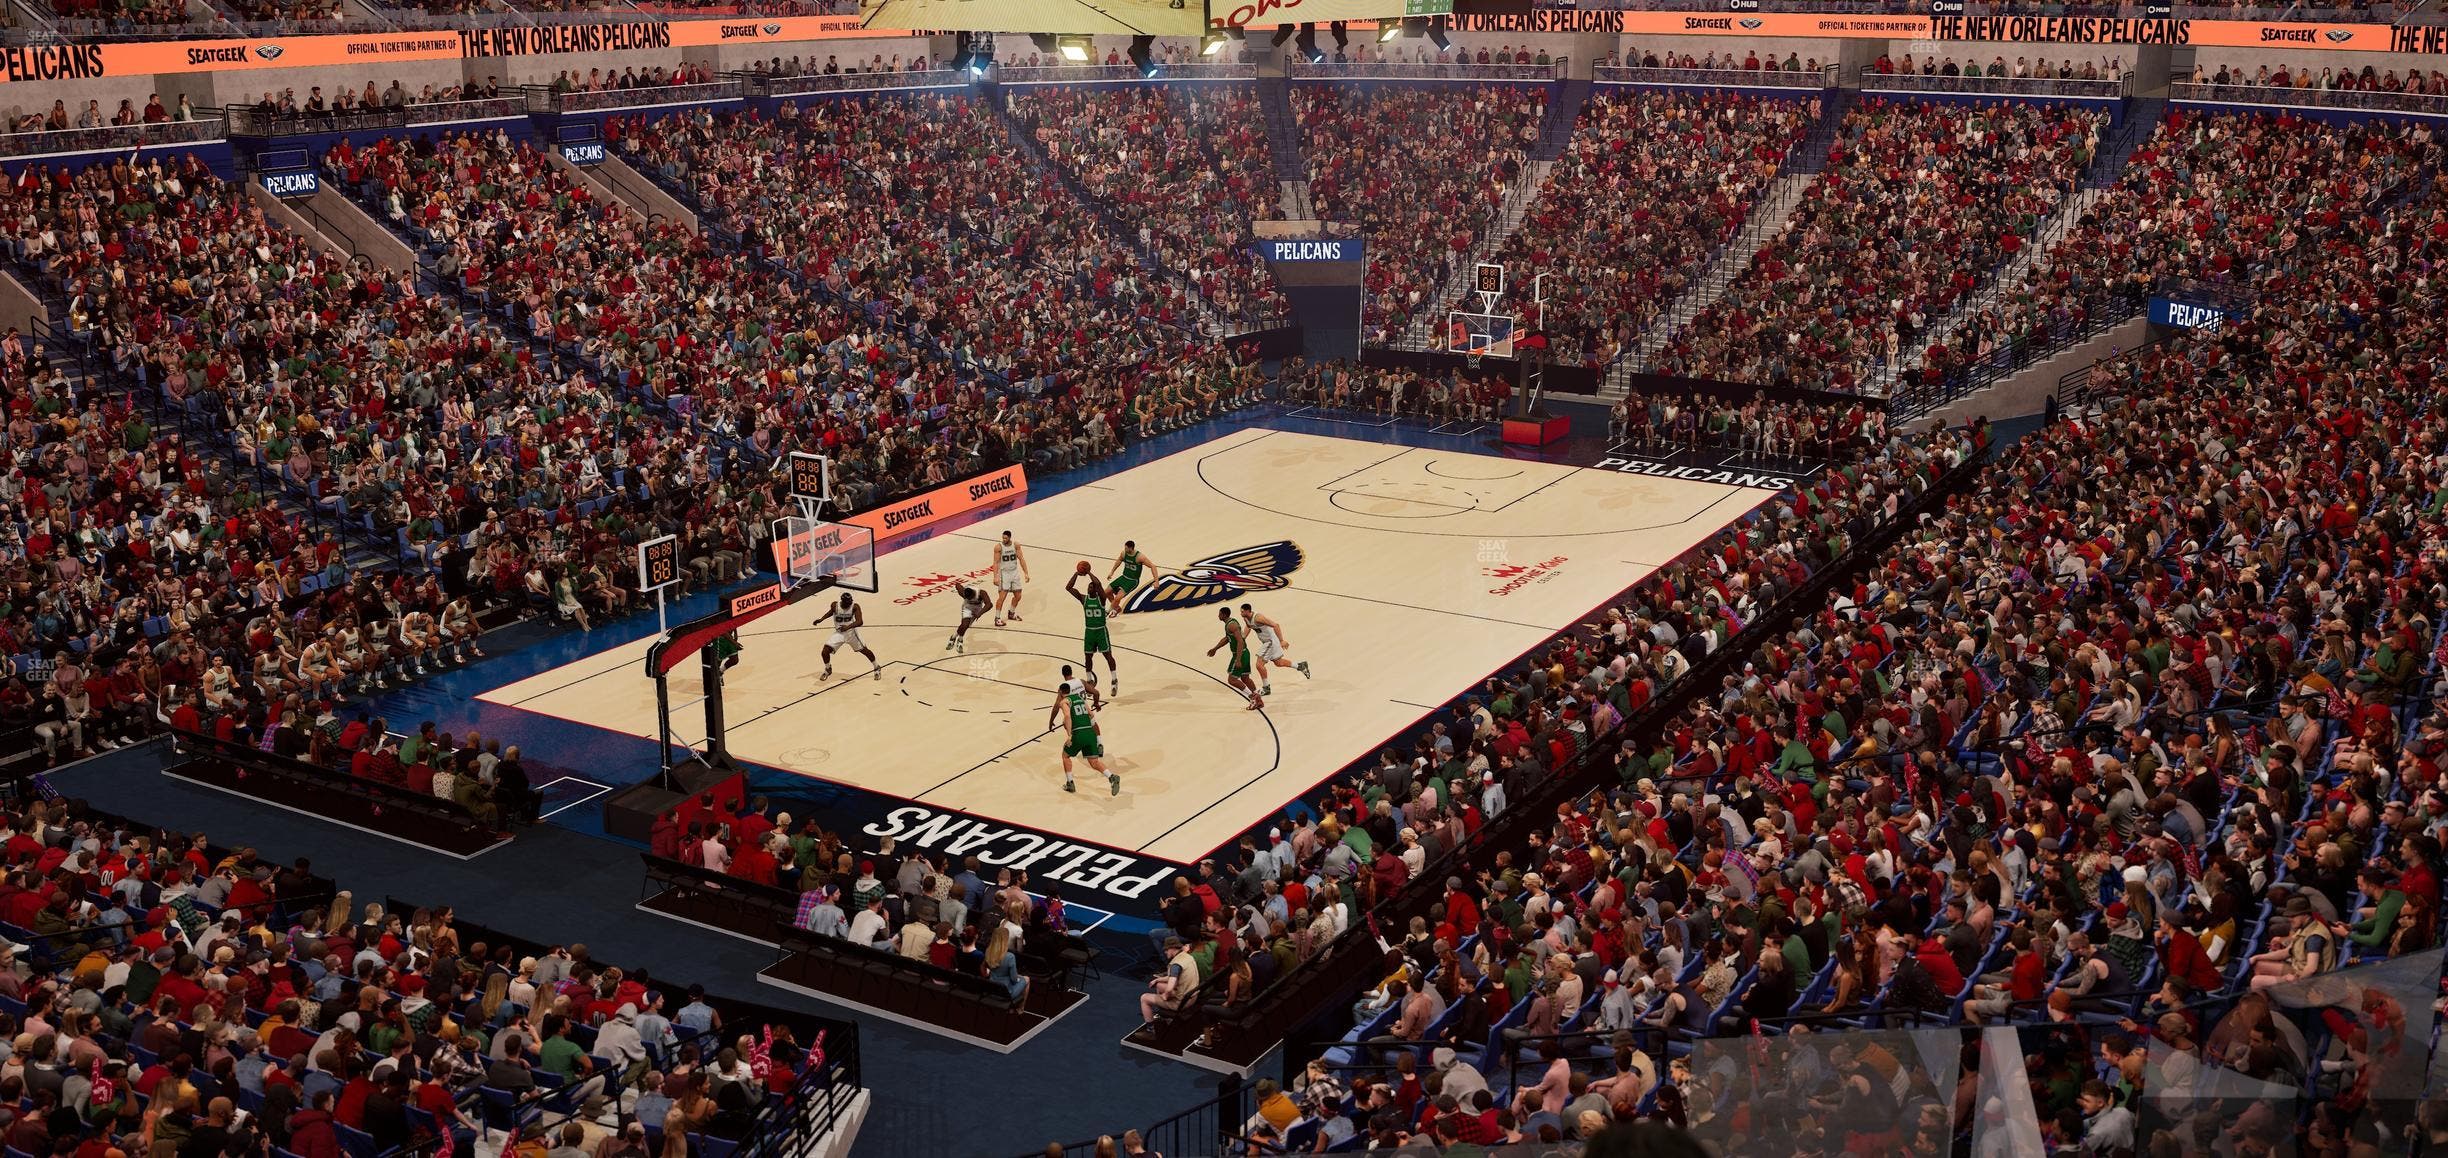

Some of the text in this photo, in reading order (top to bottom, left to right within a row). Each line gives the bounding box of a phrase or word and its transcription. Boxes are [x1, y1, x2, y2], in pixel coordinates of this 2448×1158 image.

[1740, 0, 1758, 8] HUB
[1944, 3, 1963, 11] HUB
[721, 24, 758, 39] SEATGEEK
[820, 23, 841, 32] OFFICIAL
[1551, 10, 1624, 33] PELICANS
[1685, 17, 1733, 30] SEATGEEK
[1818, 16, 2190, 45] OFFICIAL TICKETING PARTNER OF THE NEW ORLEANS PELICANS
[347, 22, 671, 58] OFFICIAL TICKETING PARTNER OF THE NEW ORLEANS PELICANS
[2261, 27, 2317, 43] SEATGEEK
[2390, 25, 2448, 54] THE NE
[188, 46, 248, 65] SEATGEEK
[565, 145, 603, 161] PELICANS
[266, 173, 316, 193] PELICANS
[1275, 242, 1341, 260] PELICANS
[1593, 457, 1795, 490] PELICANS
[969, 473, 1014, 501] SEATGEEK
[884, 499, 933, 530] SEATGEEK
[1489, 556, 1568, 596] SMOOTHIE KING
[736, 588, 776, 612] SEATGEEK
[862, 806, 1177, 899] PELICANS
